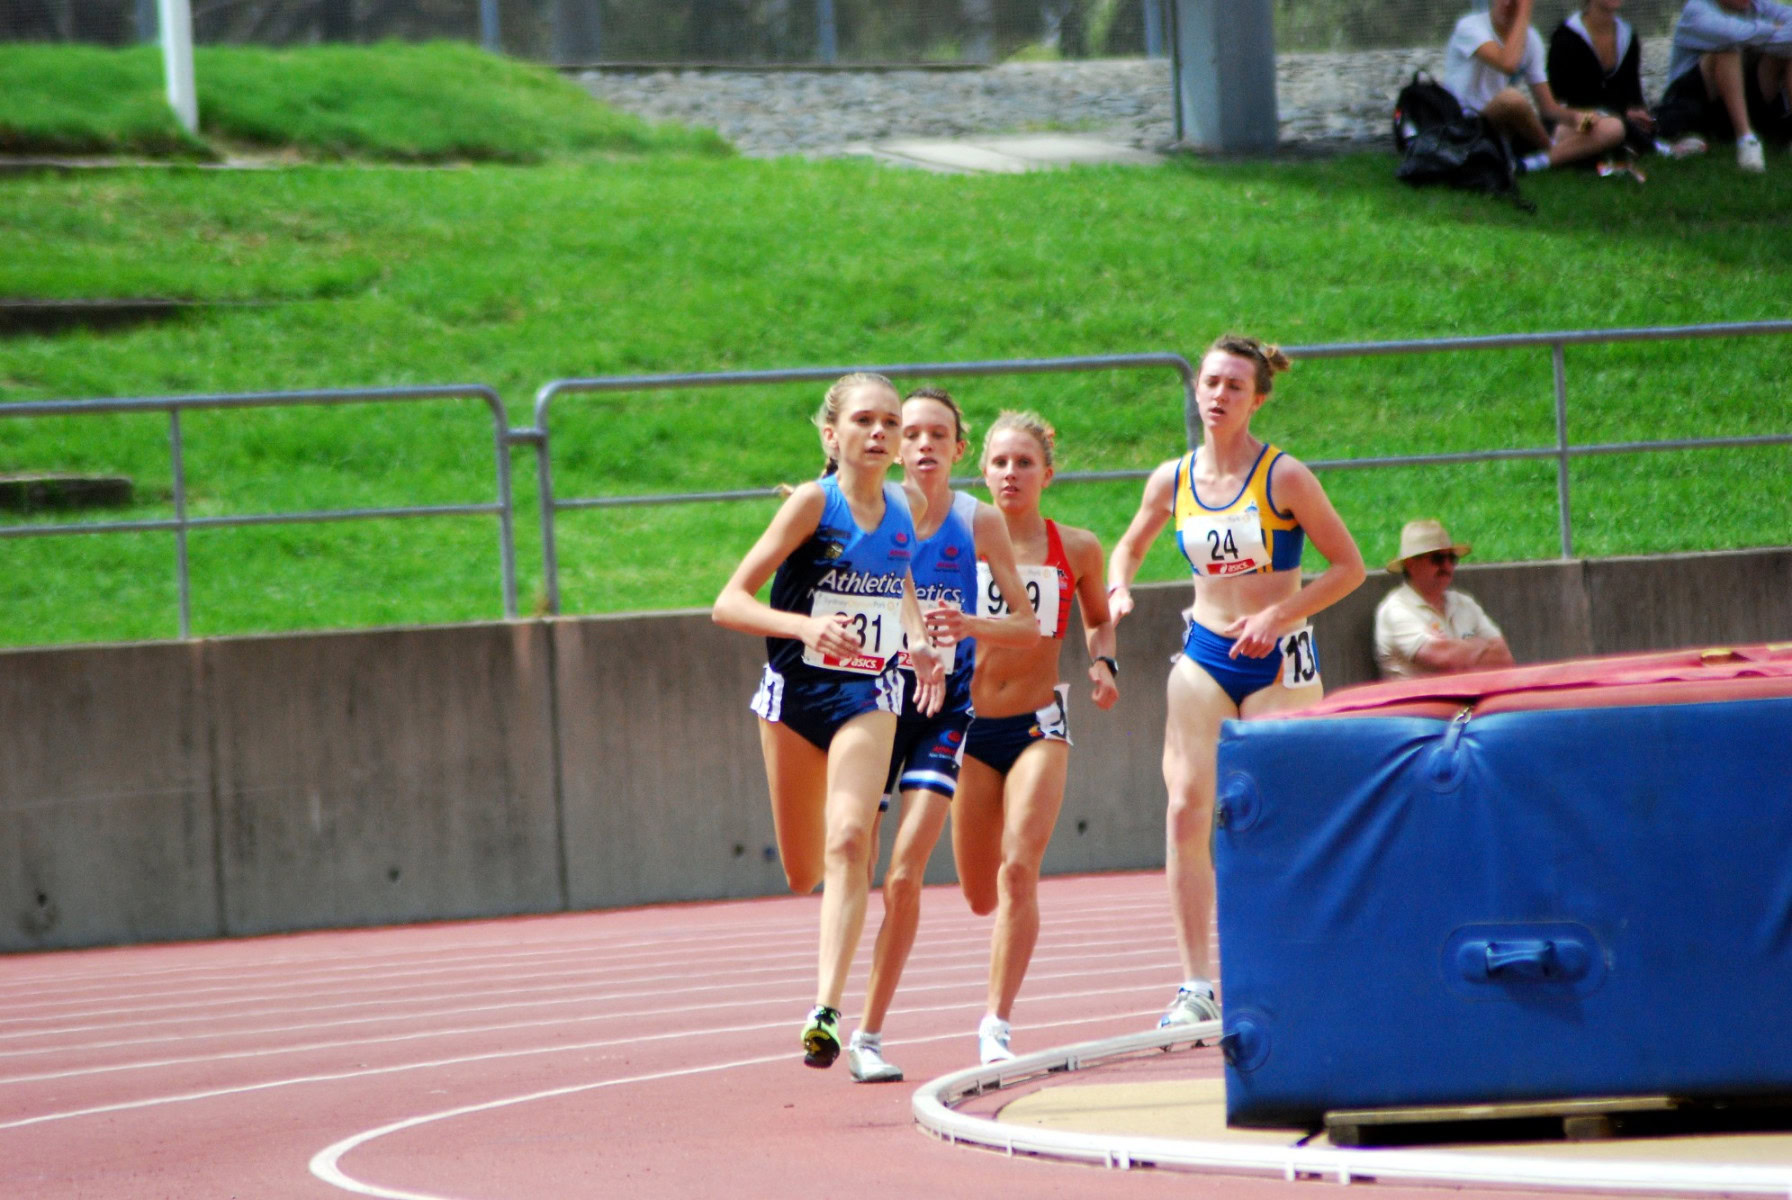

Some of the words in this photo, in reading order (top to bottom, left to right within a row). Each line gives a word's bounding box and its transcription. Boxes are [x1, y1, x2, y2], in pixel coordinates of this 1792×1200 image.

[1207, 528, 1239, 561] 24
[818, 568, 906, 595] Athletics
[987, 581, 1040, 615] 99
[1285, 630, 1316, 684] 13
